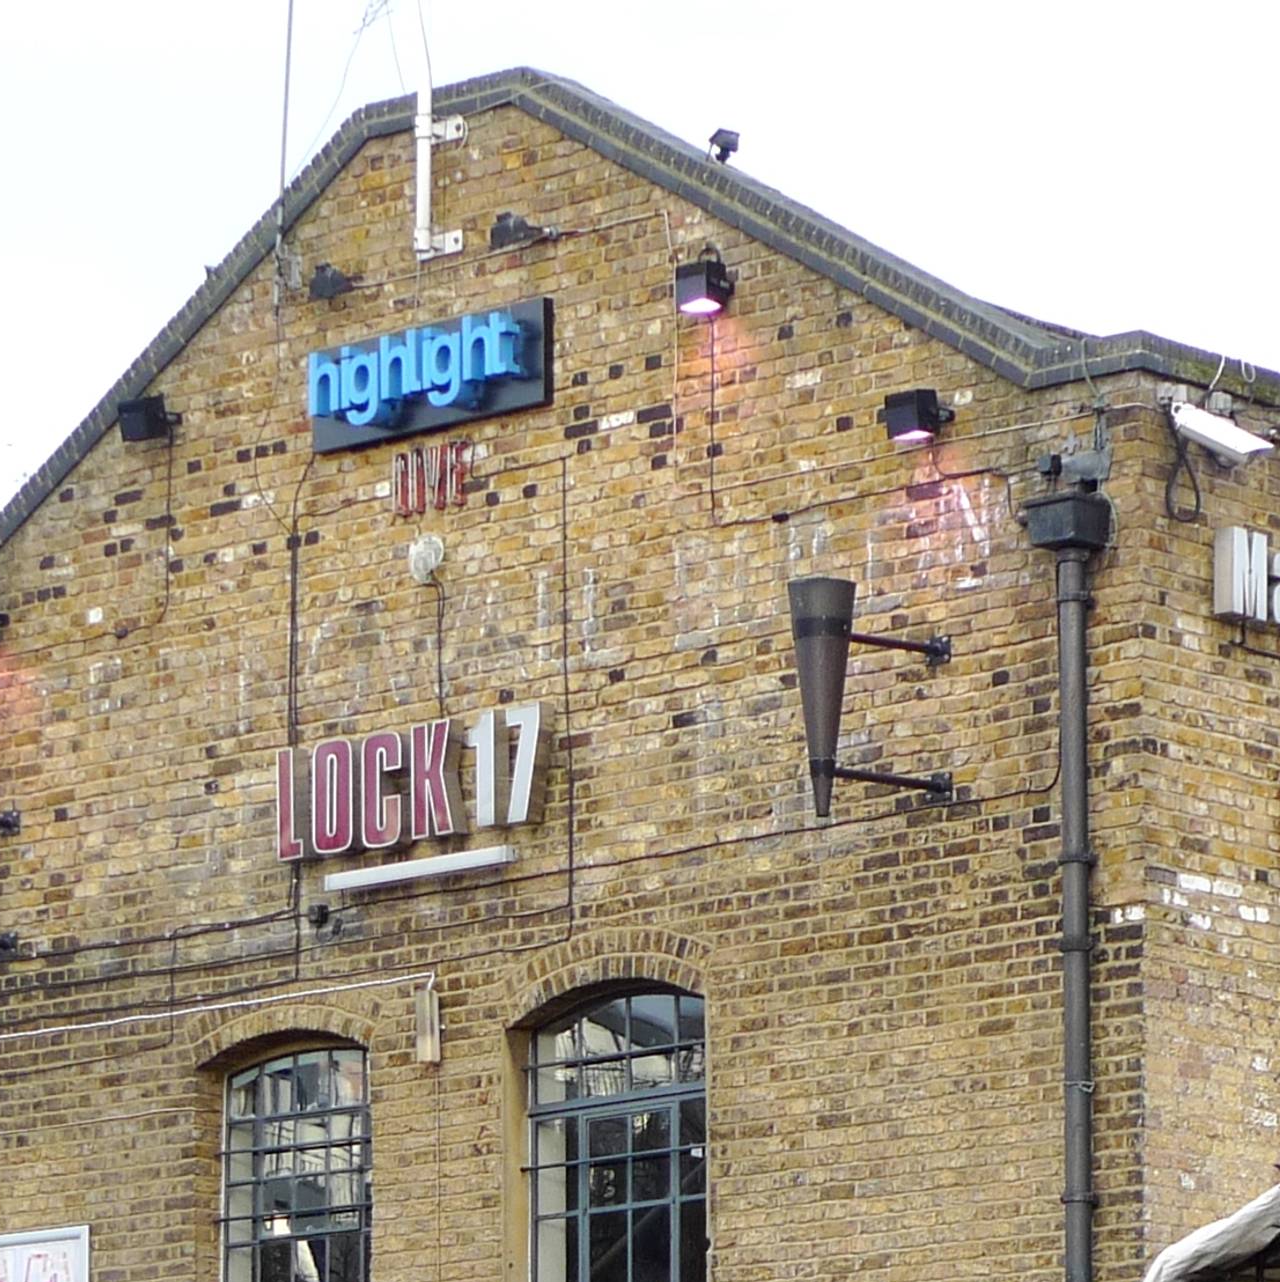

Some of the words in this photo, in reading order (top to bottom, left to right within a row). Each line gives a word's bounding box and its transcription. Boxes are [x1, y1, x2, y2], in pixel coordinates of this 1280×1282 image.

[308, 310, 521, 426] highlight
[276, 720, 452, 861] LOCK
[467, 701, 549, 828] 17
